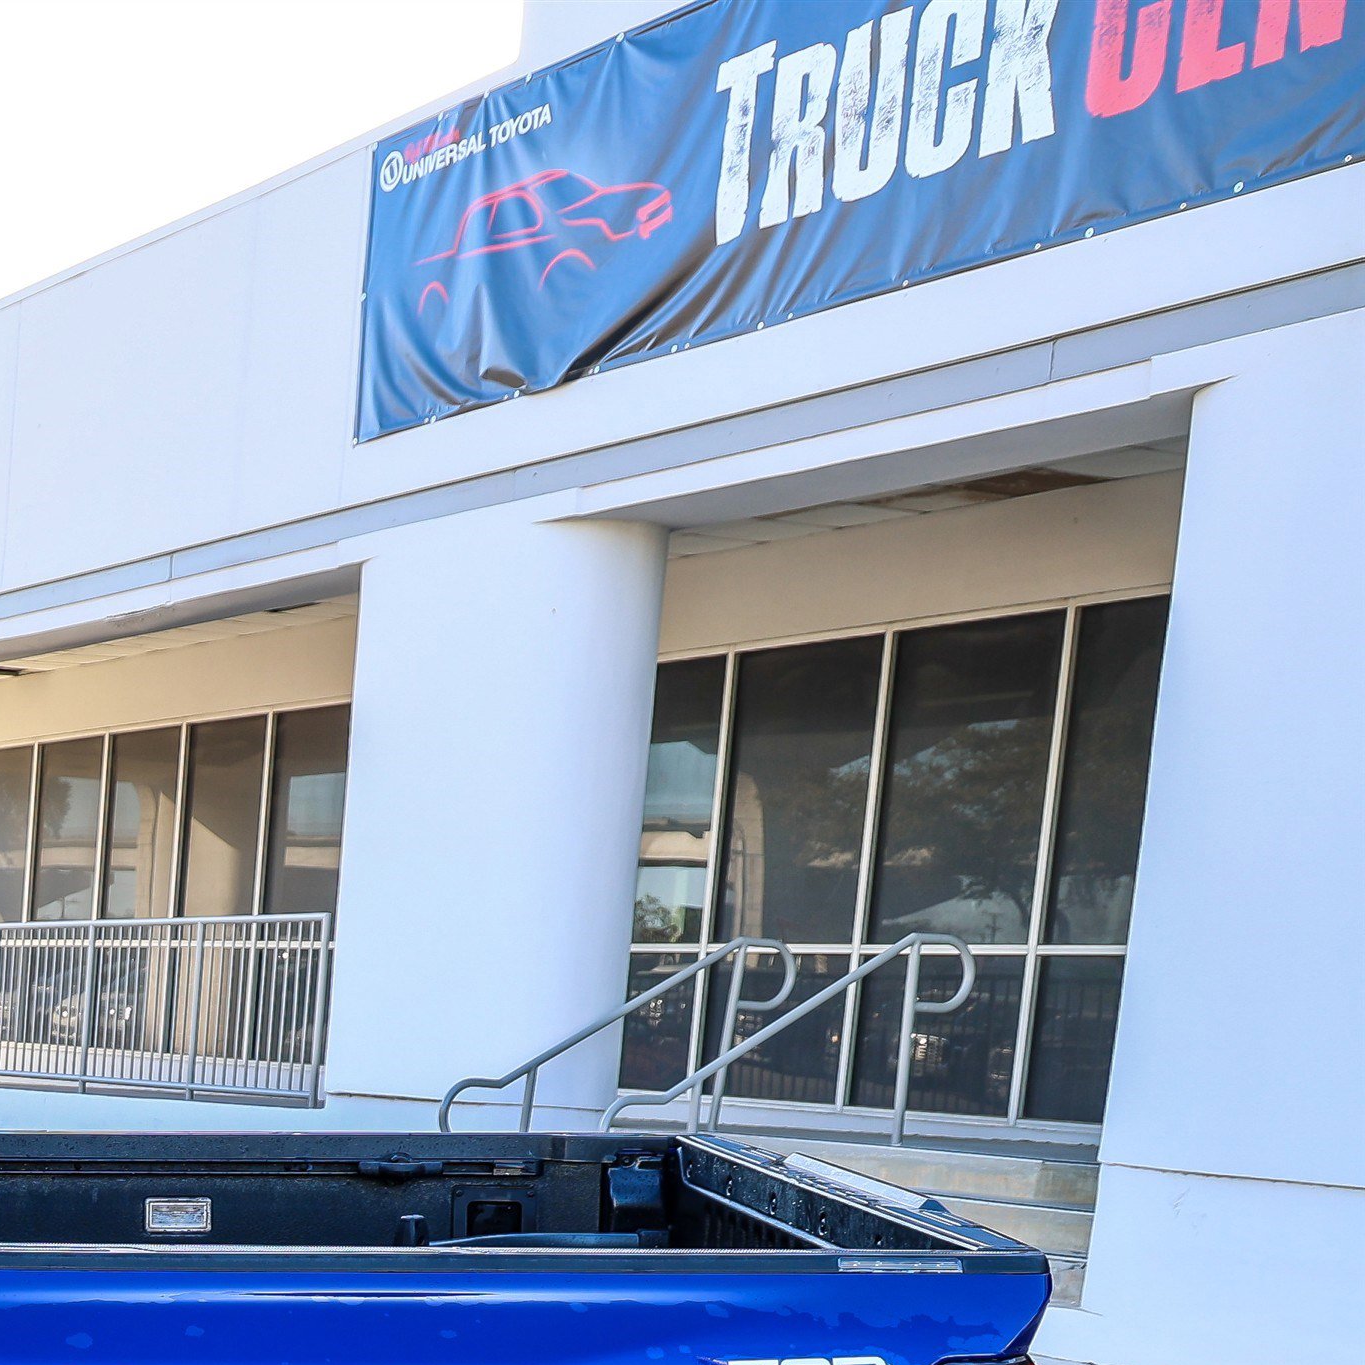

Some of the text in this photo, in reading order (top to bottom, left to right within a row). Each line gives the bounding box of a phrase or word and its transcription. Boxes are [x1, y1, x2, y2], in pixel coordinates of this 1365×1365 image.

[402, 131, 486, 185] UNIVERSAL
[488, 103, 552, 148] TOYOTA
[715, 0, 1057, 246] TRUCK
